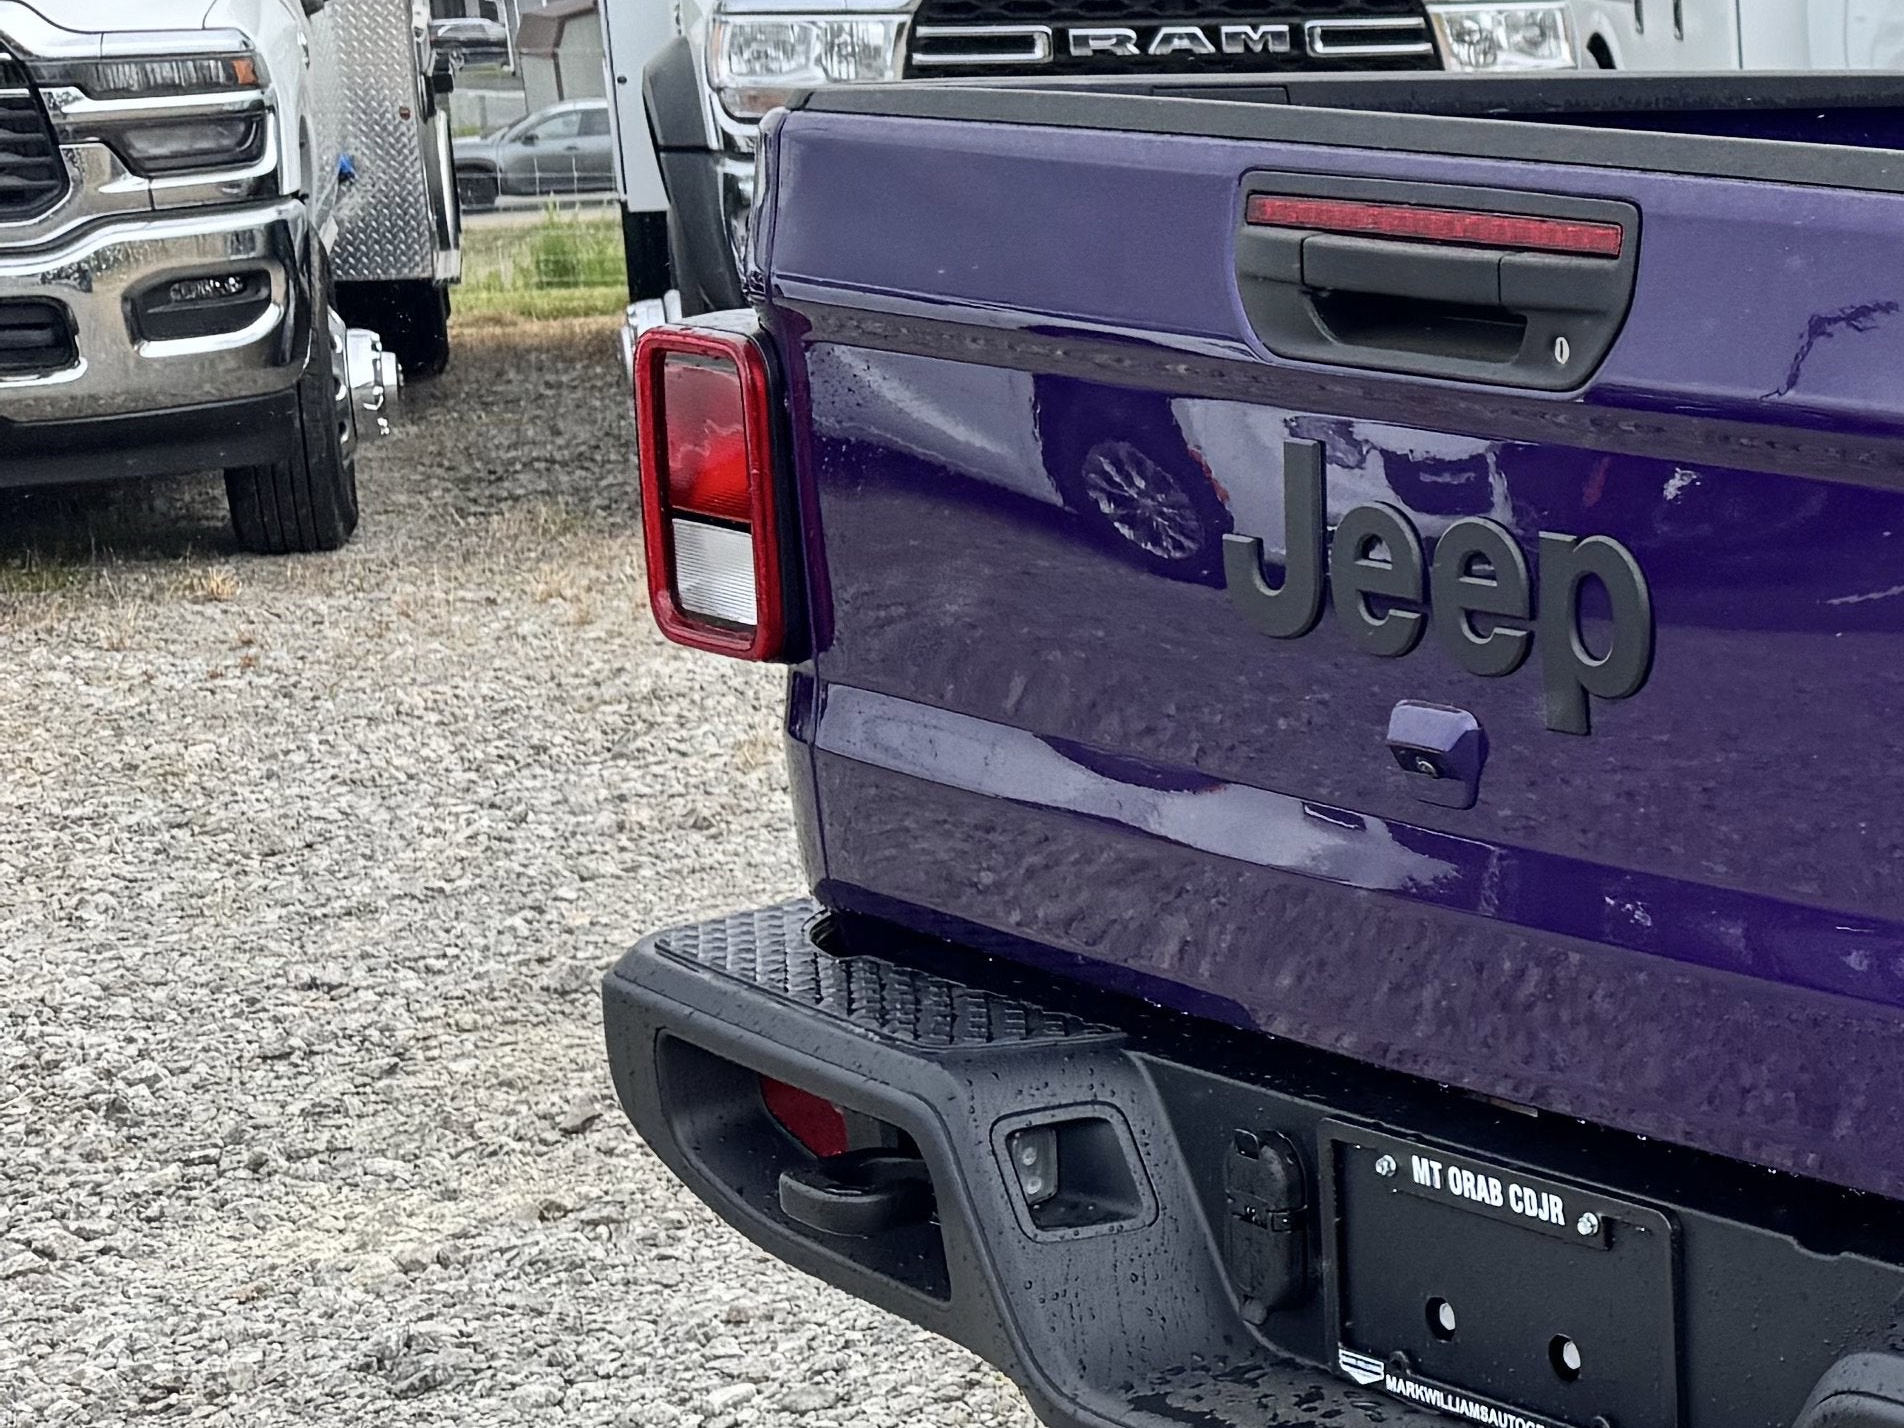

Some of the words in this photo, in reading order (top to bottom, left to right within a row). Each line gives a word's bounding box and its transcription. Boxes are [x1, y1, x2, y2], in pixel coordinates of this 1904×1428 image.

[1069, 24, 1290, 56] RAM
[1222, 436, 1656, 736] Jeep
[1411, 1154, 1443, 1190] MT
[1447, 1165, 1504, 1208] ORAB
[1508, 1183, 1566, 1226] CDJR
